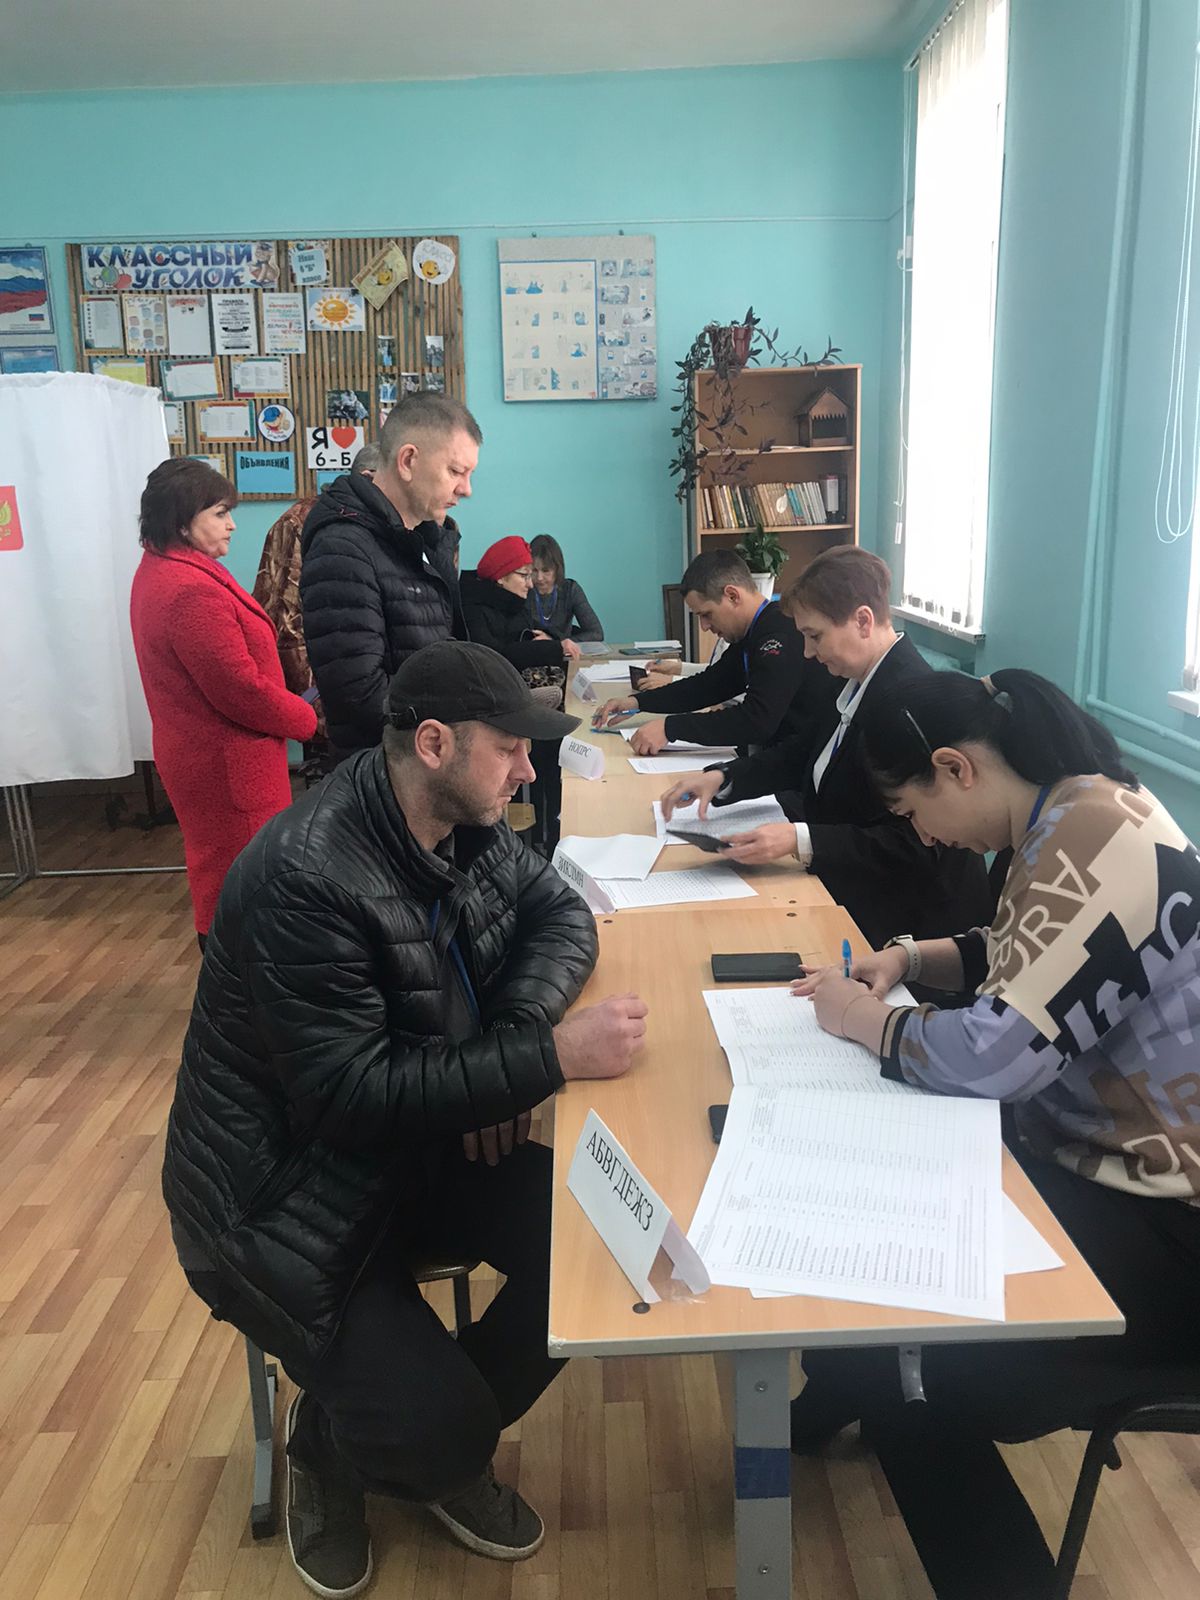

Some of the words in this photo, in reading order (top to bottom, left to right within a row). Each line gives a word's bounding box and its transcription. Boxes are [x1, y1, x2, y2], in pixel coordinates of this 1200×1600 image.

[87, 244, 253, 267] КЛАССНЫЙ
[132, 267, 246, 289] УГОЛОК
[312, 427, 328, 449] Я
[240, 456, 290, 470] ОБЪЯВЛЕНИЯ
[586, 1130, 654, 1231] АБВГДЕЖЗ
